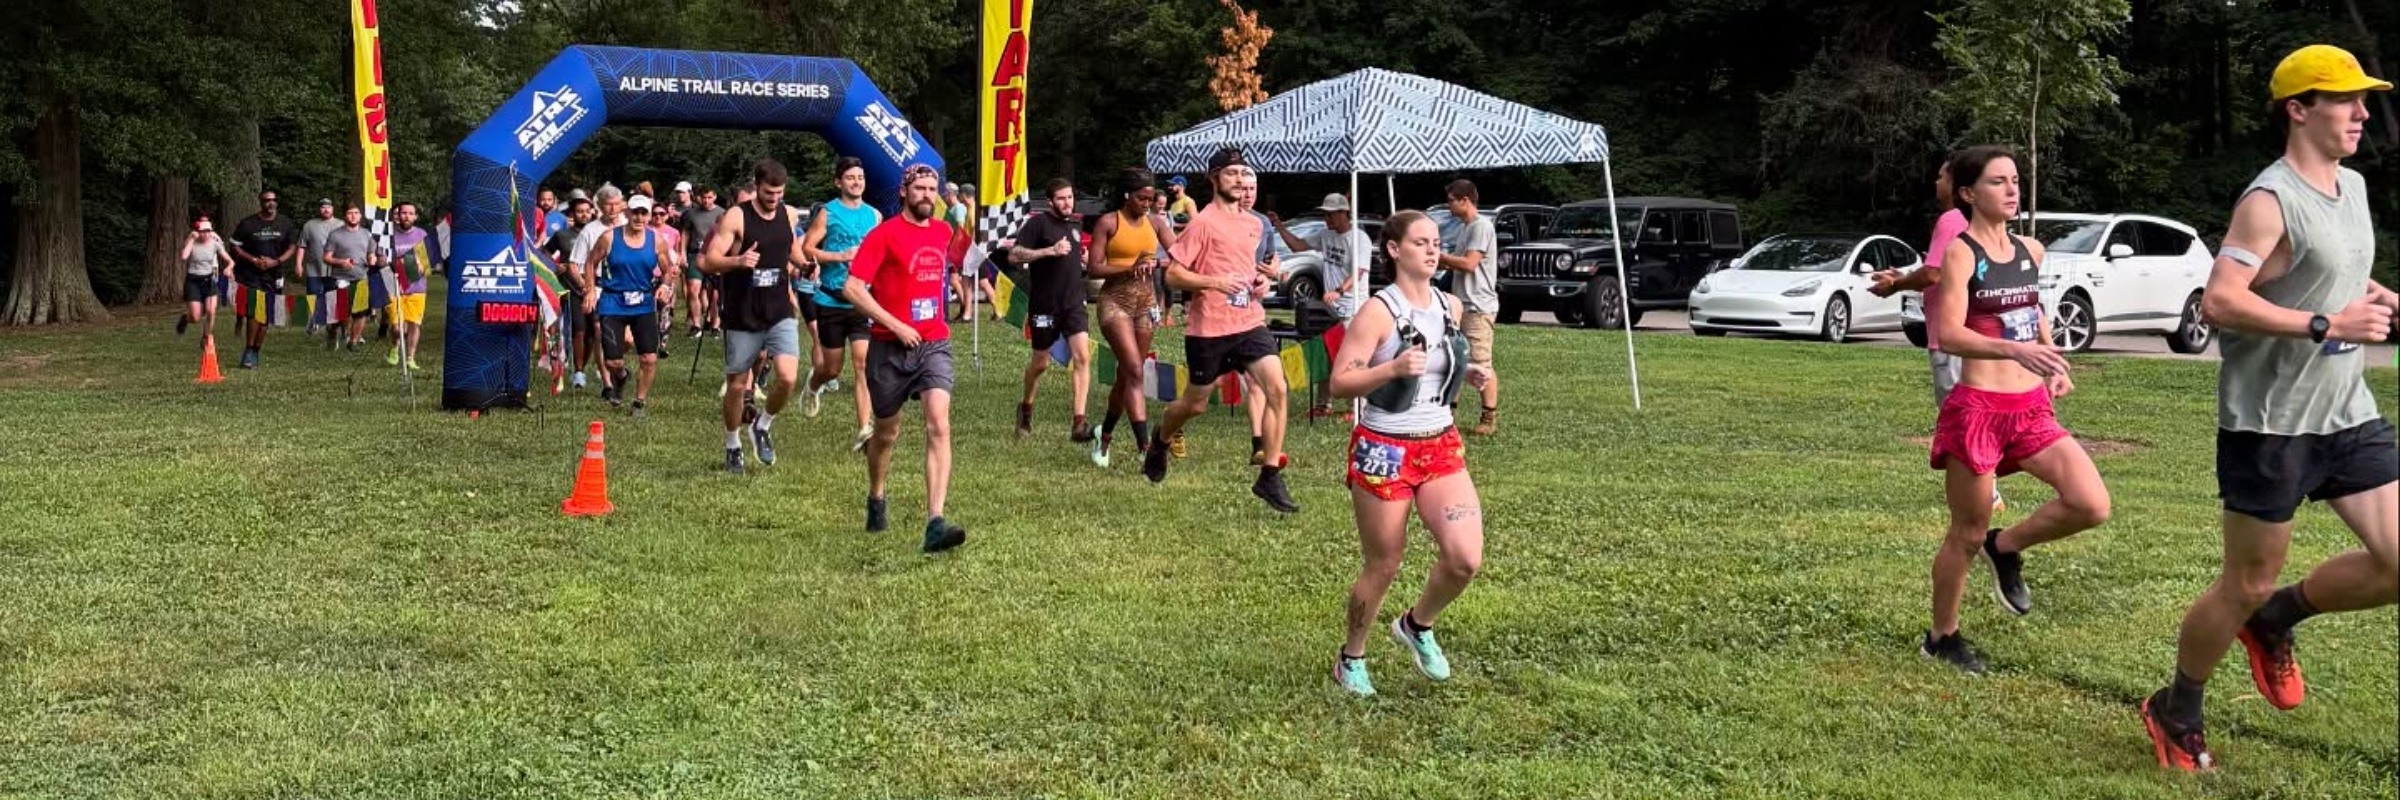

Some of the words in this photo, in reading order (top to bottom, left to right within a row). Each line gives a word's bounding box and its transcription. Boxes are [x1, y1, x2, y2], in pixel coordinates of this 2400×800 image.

[619, 76, 679, 93] ALPINE
[681, 78, 730, 95] TRAIL
[731, 81, 774, 96] RACE
[777, 83, 830, 99] SERIES
[518, 88, 579, 147] ATRS
[866, 102, 917, 157] ATRS
[462, 265, 527, 277] ATRS
[2001, 294, 2029, 305] ELITE
[1363, 457, 1388, 476] 273
